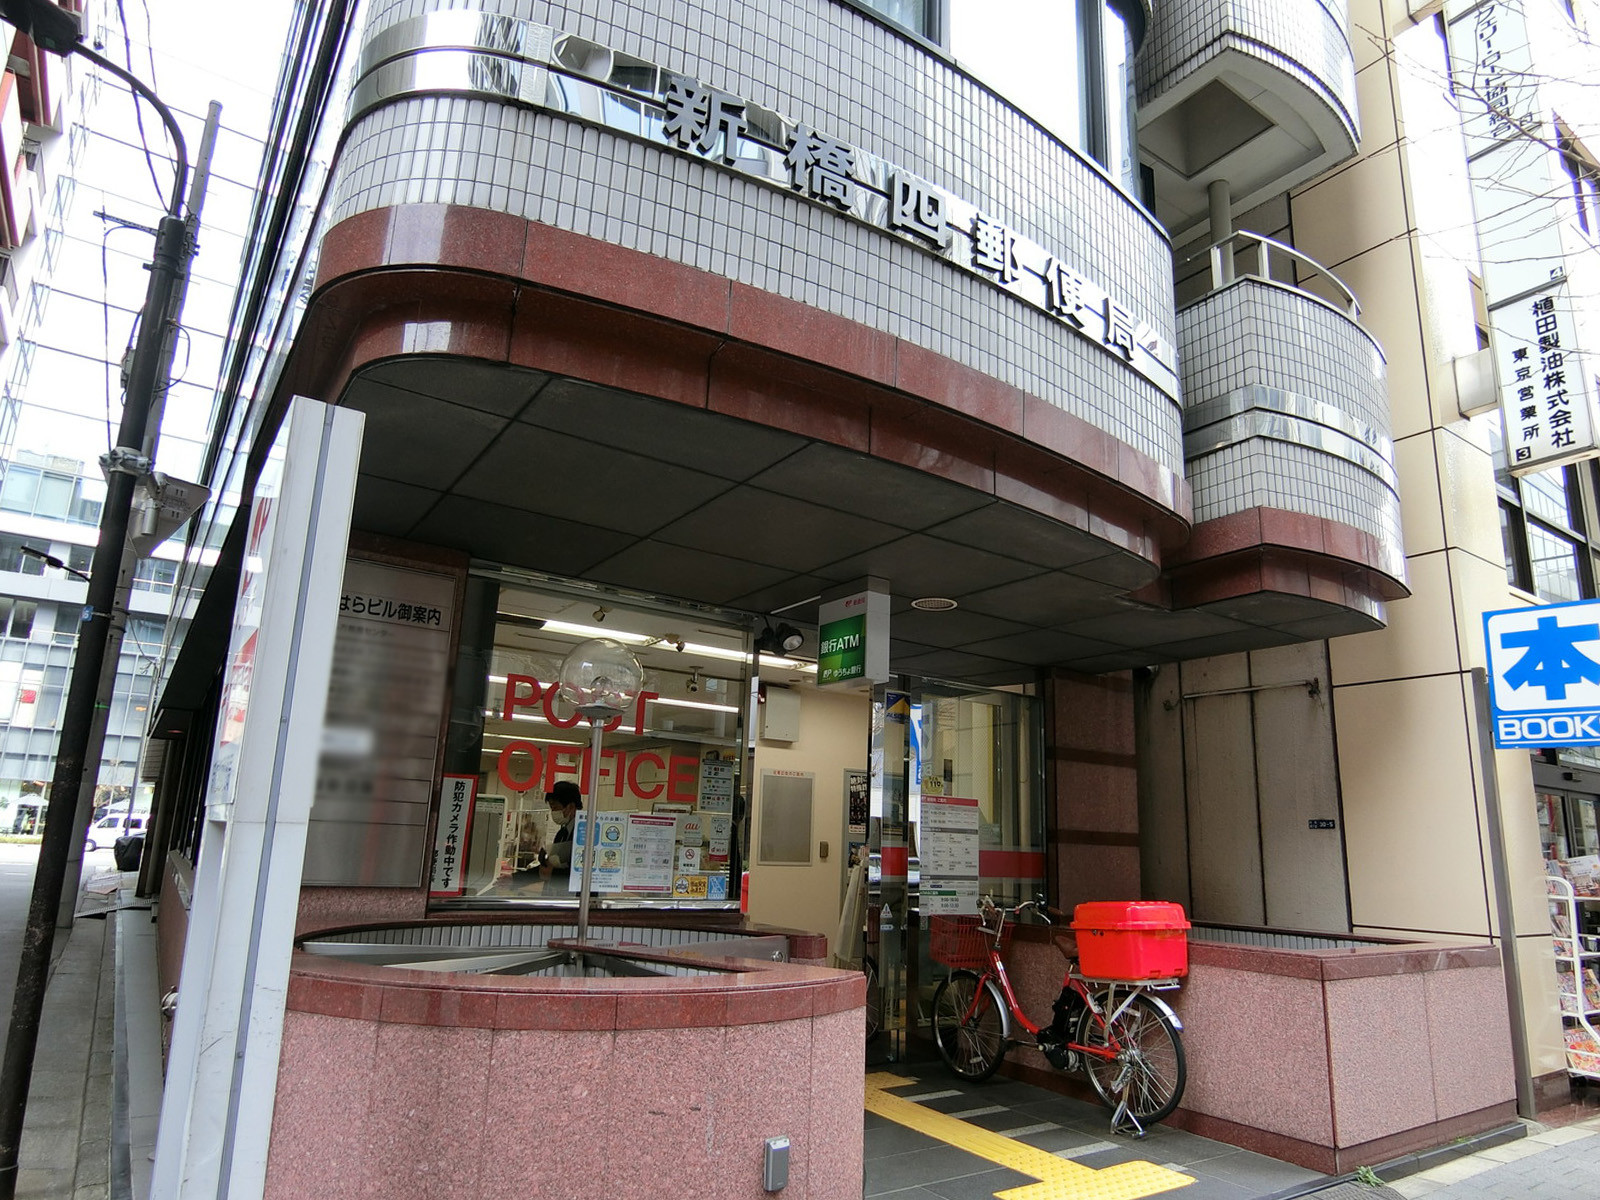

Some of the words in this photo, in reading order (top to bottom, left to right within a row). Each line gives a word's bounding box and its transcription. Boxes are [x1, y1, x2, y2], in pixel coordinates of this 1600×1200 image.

[663, 76, 1137, 362] 新橋四郵便局
[1550, 266, 1563, 279] 4
[1512, 347, 1540, 442] 東京営業所
[1532, 296, 1576, 449] 植田製油株式会社
[1517, 447, 1531, 461] 3
[821, 633, 861, 655] 銀行ATM
[1500, 616, 1600, 701] 本
[1498, 716, 1600, 740] BOOK
[498, 741, 700, 803] OFFICE
[441, 780, 466, 889] 防犯カメラ作動中です
[685, 822, 700, 830] au
